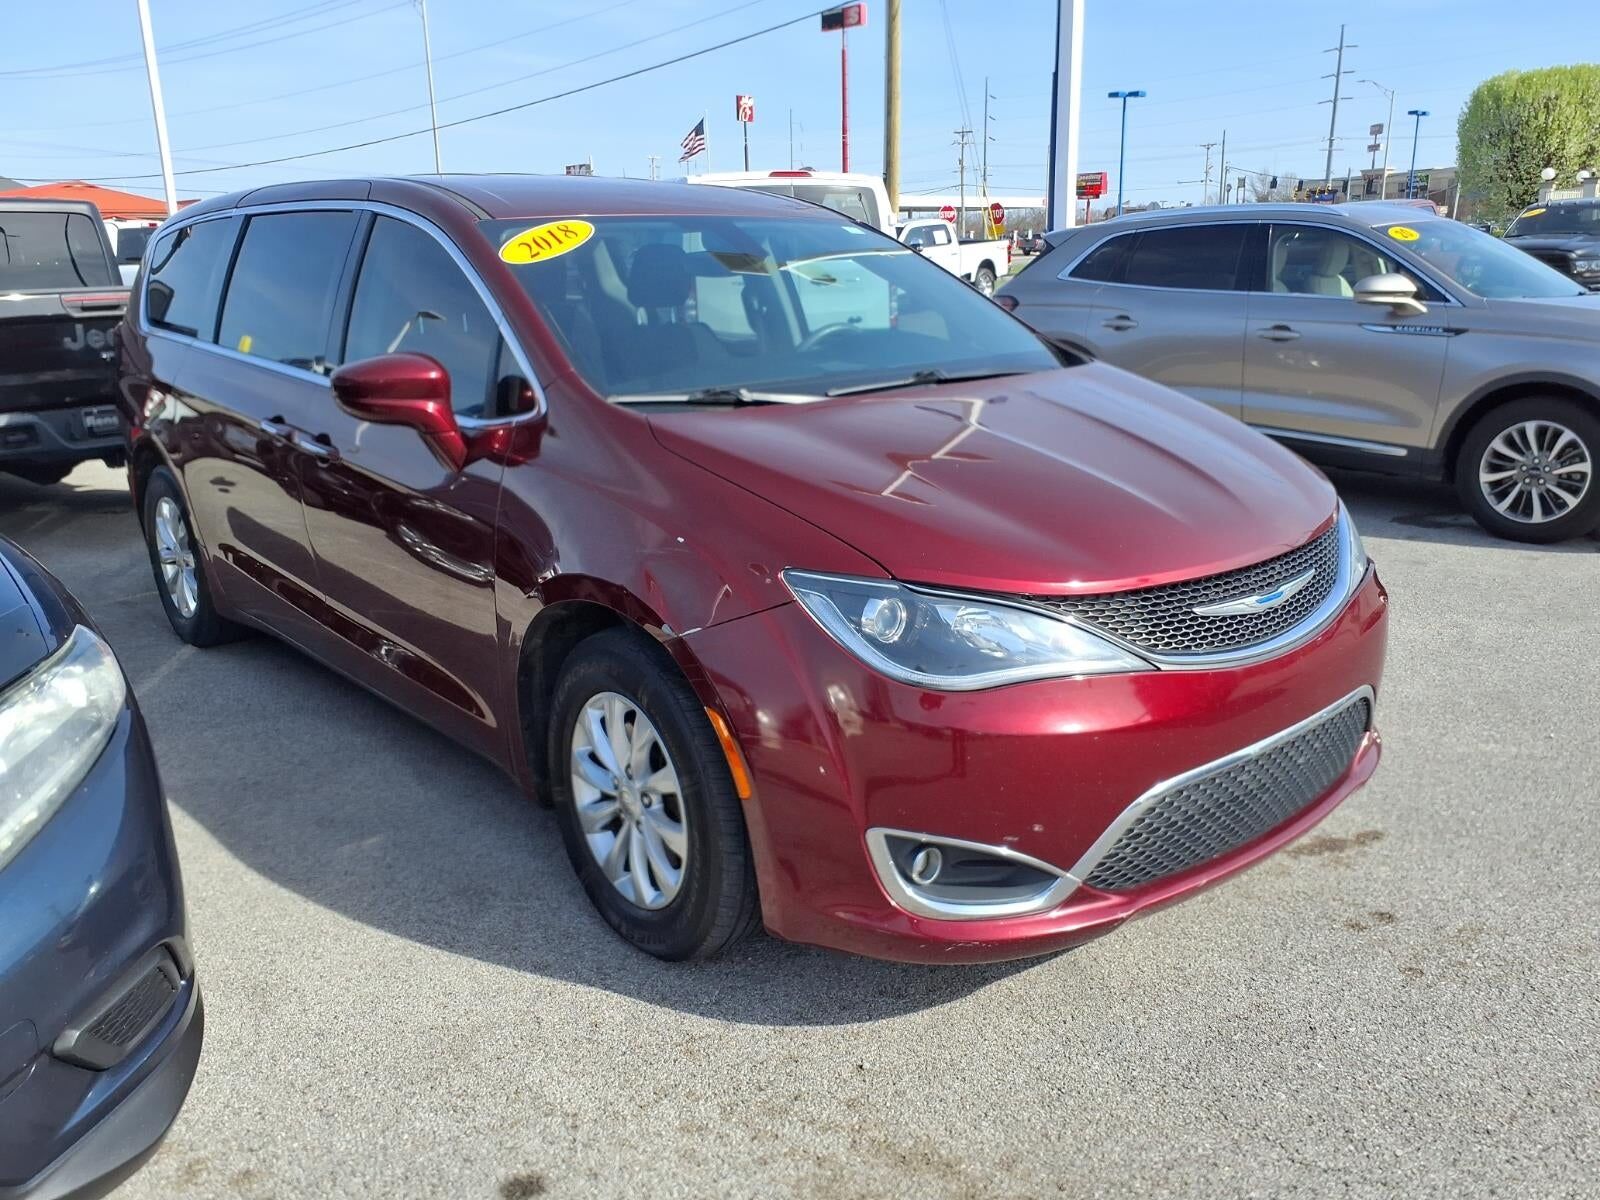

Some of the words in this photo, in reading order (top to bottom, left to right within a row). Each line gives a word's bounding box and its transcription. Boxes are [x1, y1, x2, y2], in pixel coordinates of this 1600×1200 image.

[940, 211, 955, 219] STOP
[990, 209, 1004, 219] TOP
[518, 224, 578, 259] 2018
[64, 323, 114, 351] Je
